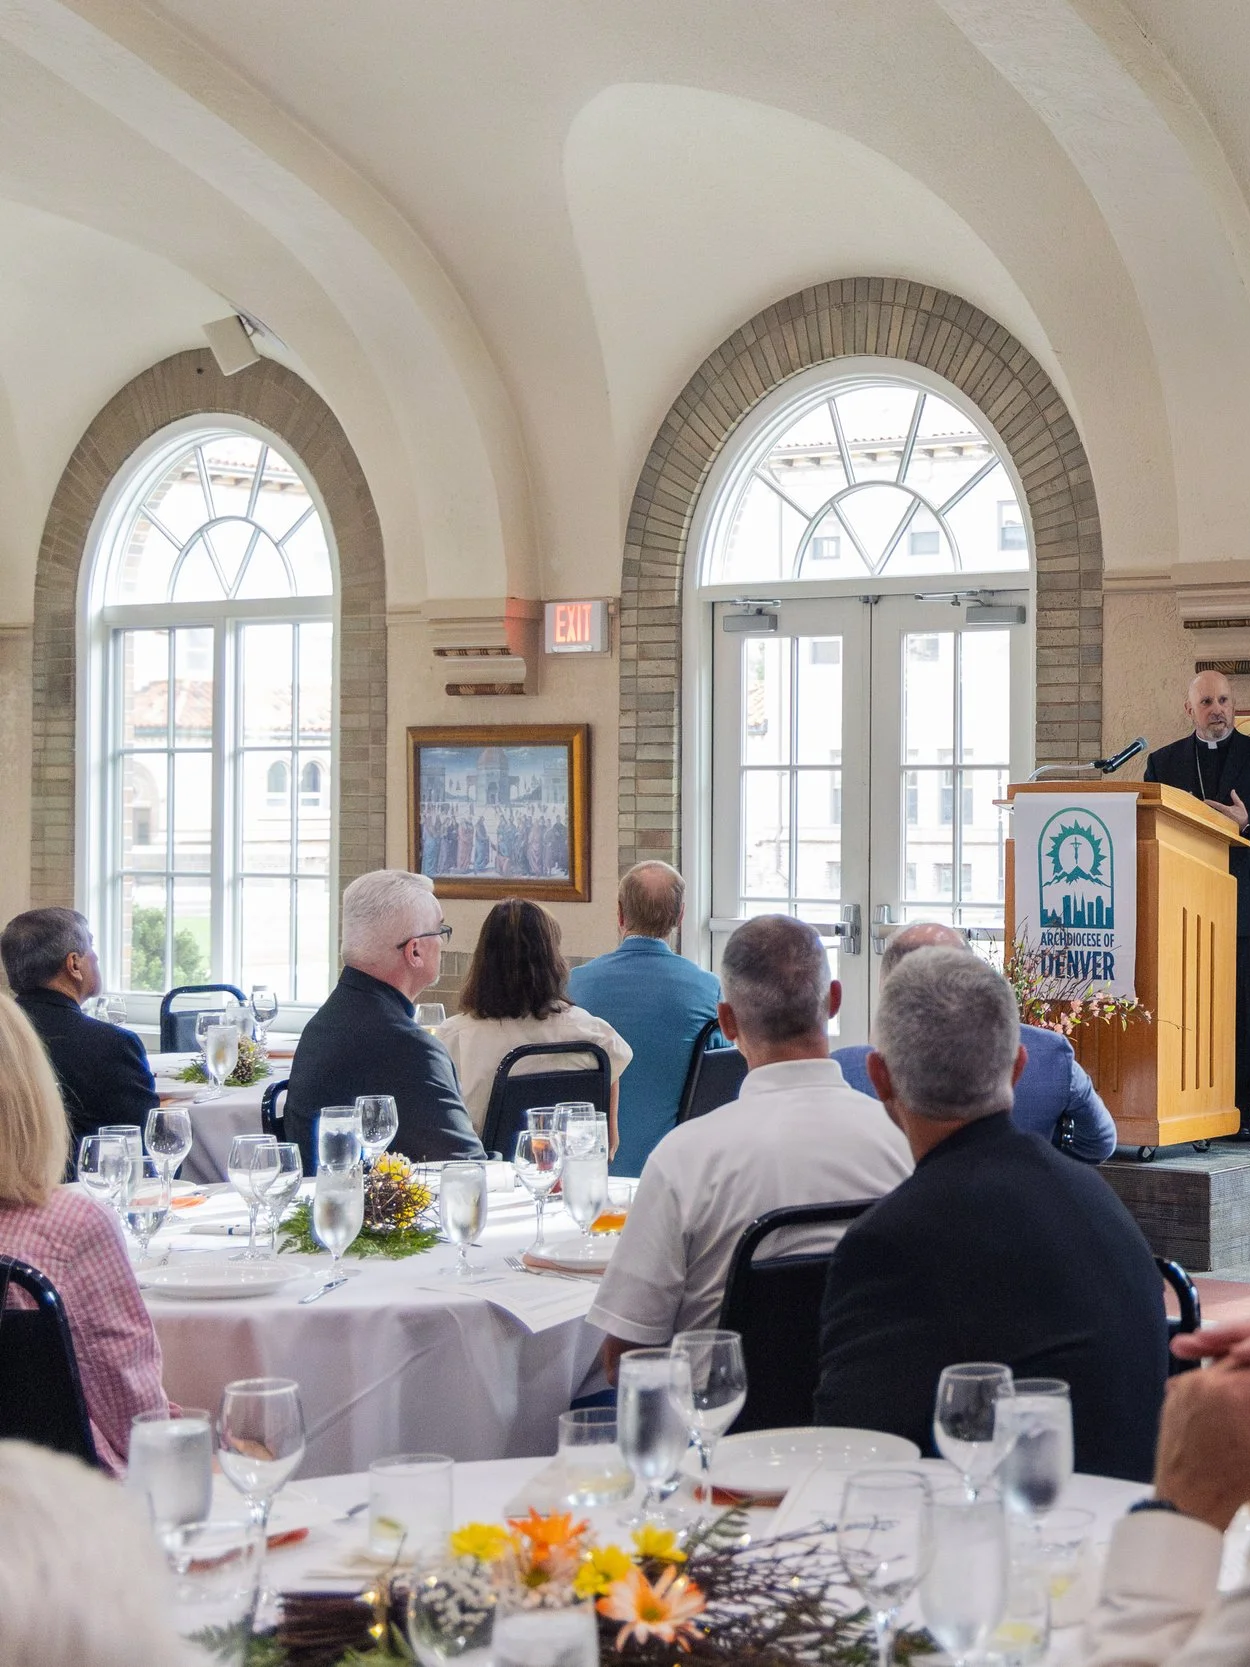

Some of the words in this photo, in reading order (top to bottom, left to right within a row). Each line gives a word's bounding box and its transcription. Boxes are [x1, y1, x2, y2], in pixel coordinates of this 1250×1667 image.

[555, 604, 592, 642] EXIT
[1040, 932, 1101, 947] ARCHDIOCESE
[1103, 933, 1115, 947] OF
[1040, 949, 1115, 981] DENVER
